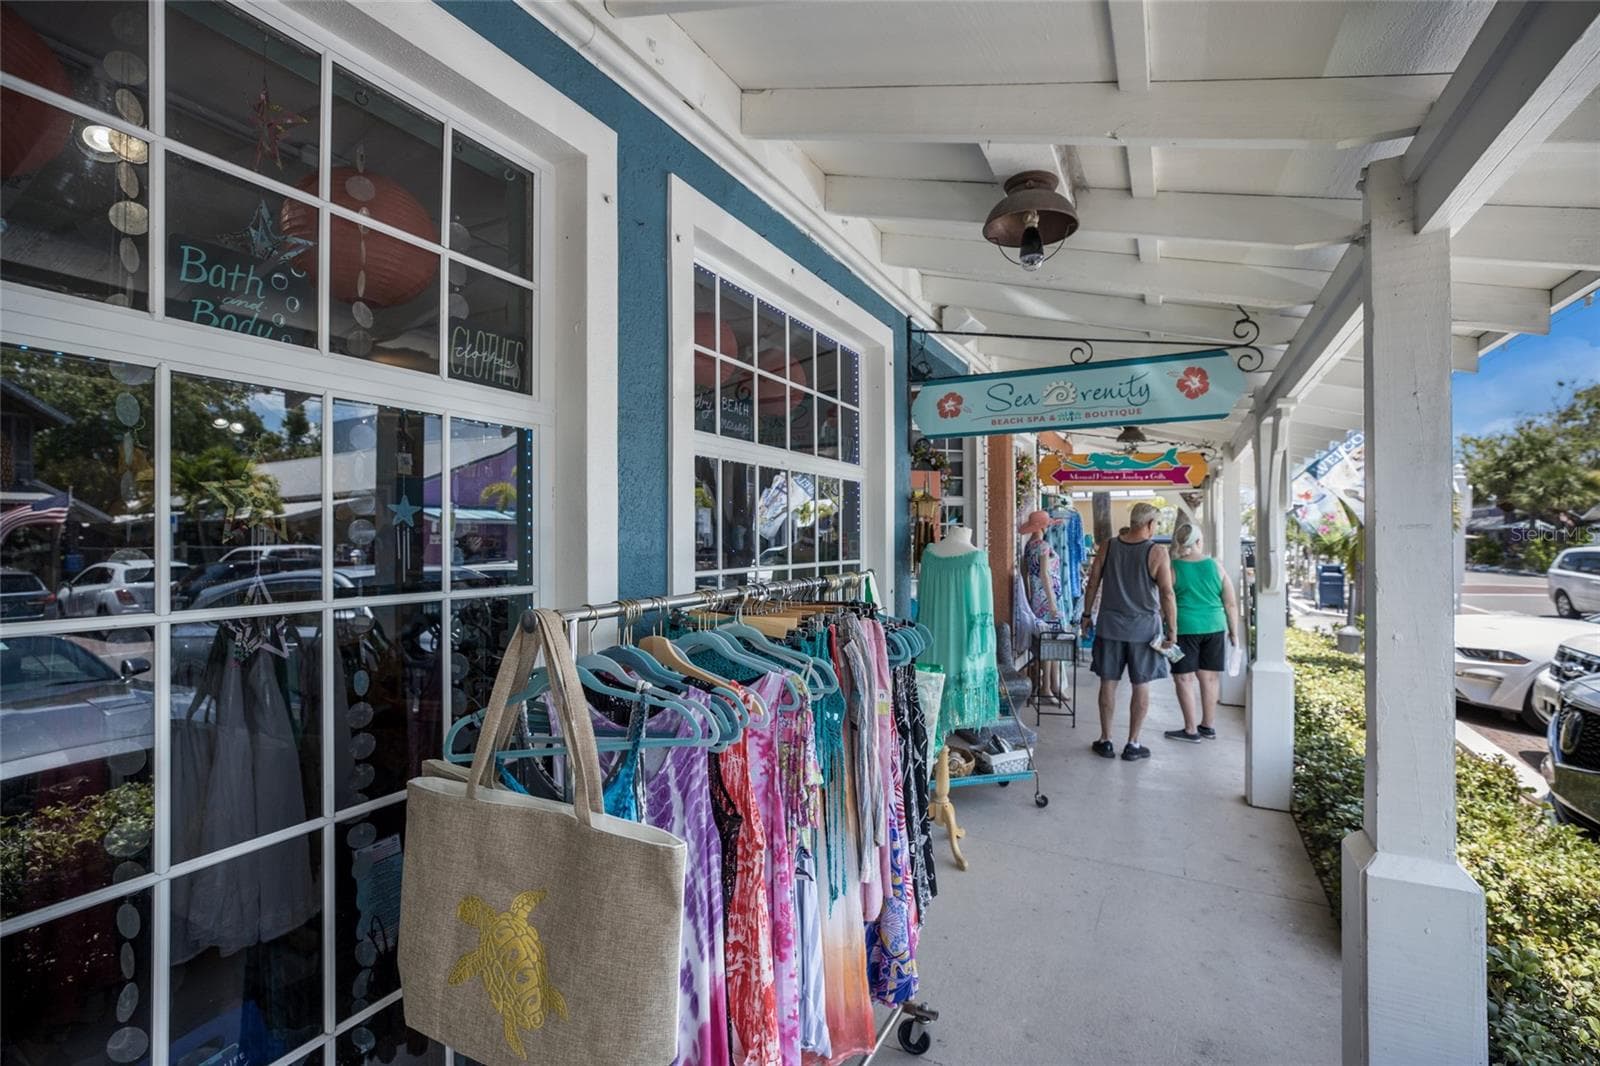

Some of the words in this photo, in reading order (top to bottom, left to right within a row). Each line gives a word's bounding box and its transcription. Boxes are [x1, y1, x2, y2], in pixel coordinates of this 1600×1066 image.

[180, 244, 265, 298] Bath
[223, 297, 263, 312] and
[451, 326, 523, 388] CLOTHES
[721, 396, 749, 417] BEACH
[986, 383, 1039, 411] Sea
[1081, 373, 1149, 406] renity
[993, 417, 1024, 426] BEACH
[1029, 415, 1045, 423] SPA
[1086, 407, 1142, 418] BOUTIQUE
